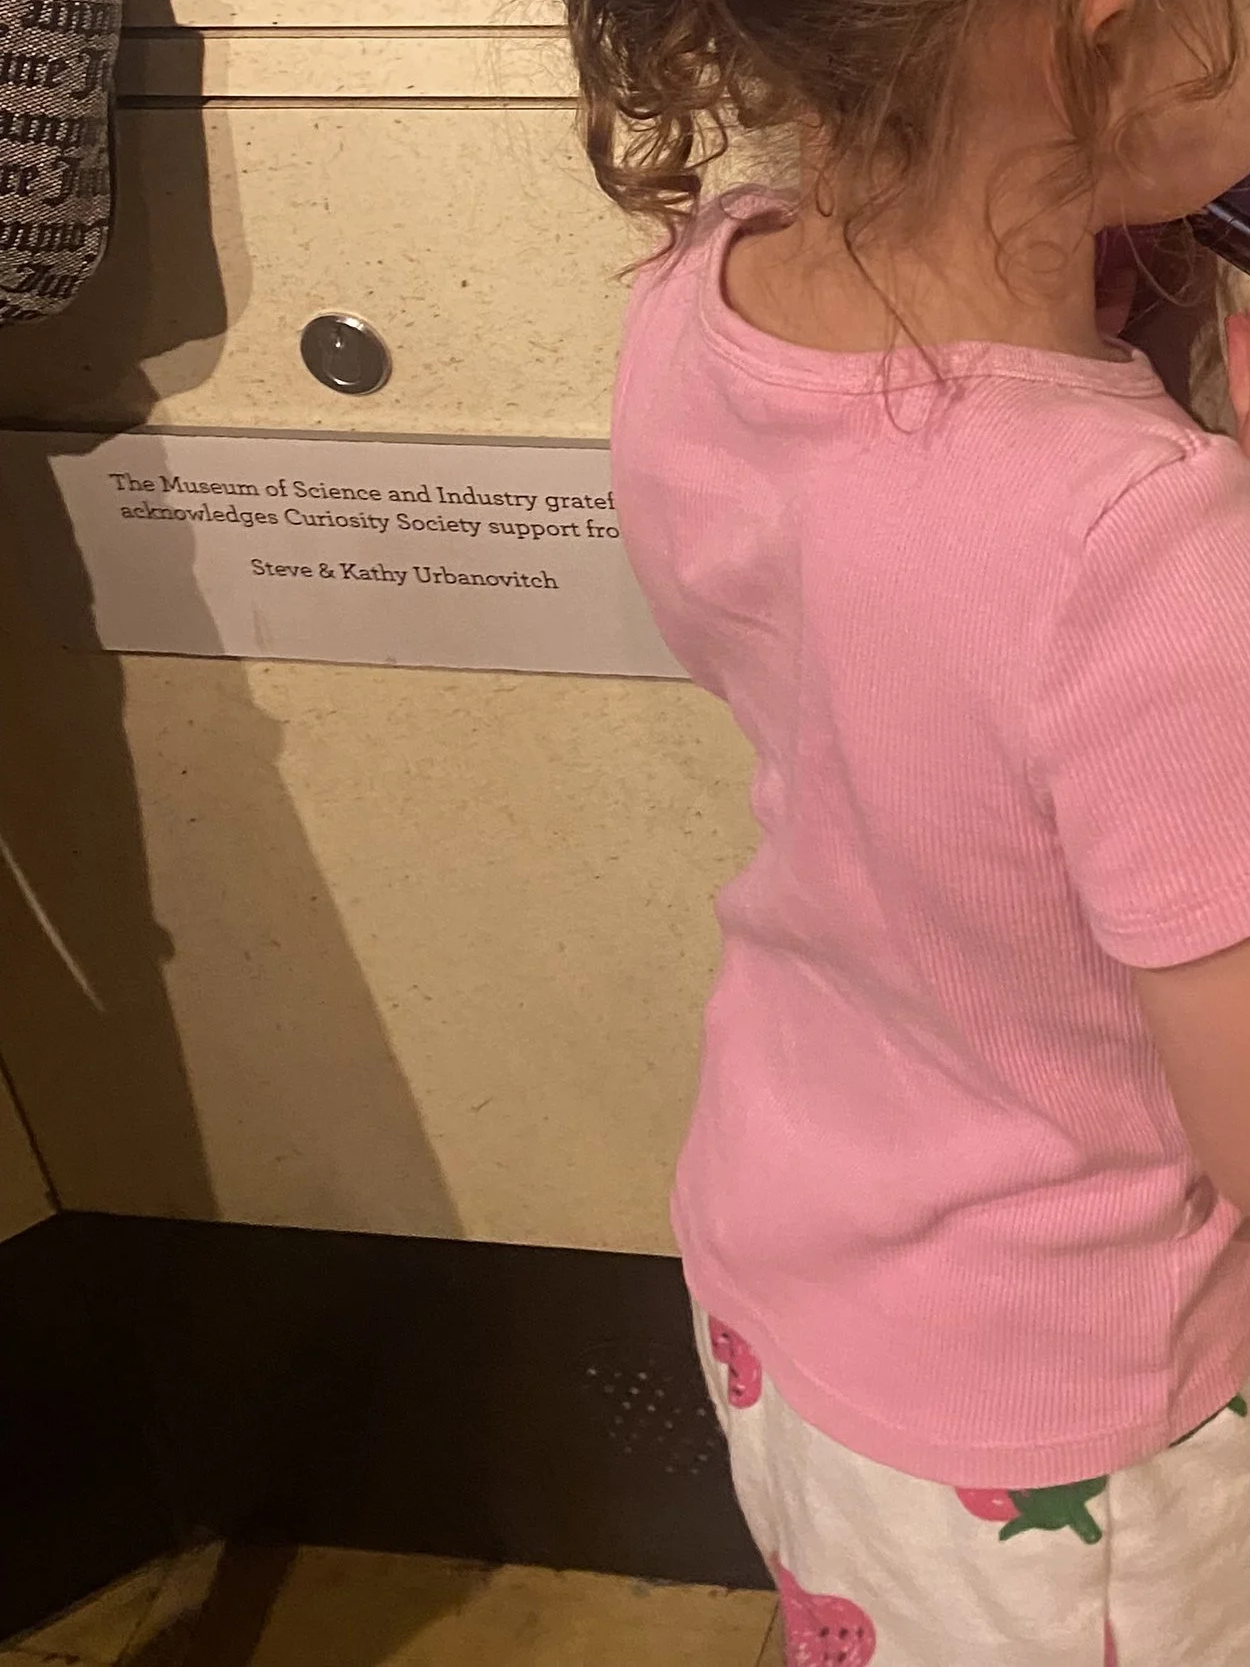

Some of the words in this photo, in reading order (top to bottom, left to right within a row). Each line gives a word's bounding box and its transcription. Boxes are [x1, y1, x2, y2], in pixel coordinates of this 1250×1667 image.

[108, 473, 156, 492] The
[159, 476, 260, 497] Museum
[265, 478, 288, 497] of
[292, 481, 382, 501] Science
[388, 484, 433, 503] and
[435, 486, 538, 511] Industry
[120, 502, 280, 527] acknowledges
[284, 508, 390, 534] Curiosity
[396, 513, 482, 537] Society
[488, 522, 581, 541] support
[251, 558, 313, 578] Steve
[319, 563, 336, 579] &
[338, 563, 408, 586] Kathy
[412, 566, 560, 589] Urbanovitch
